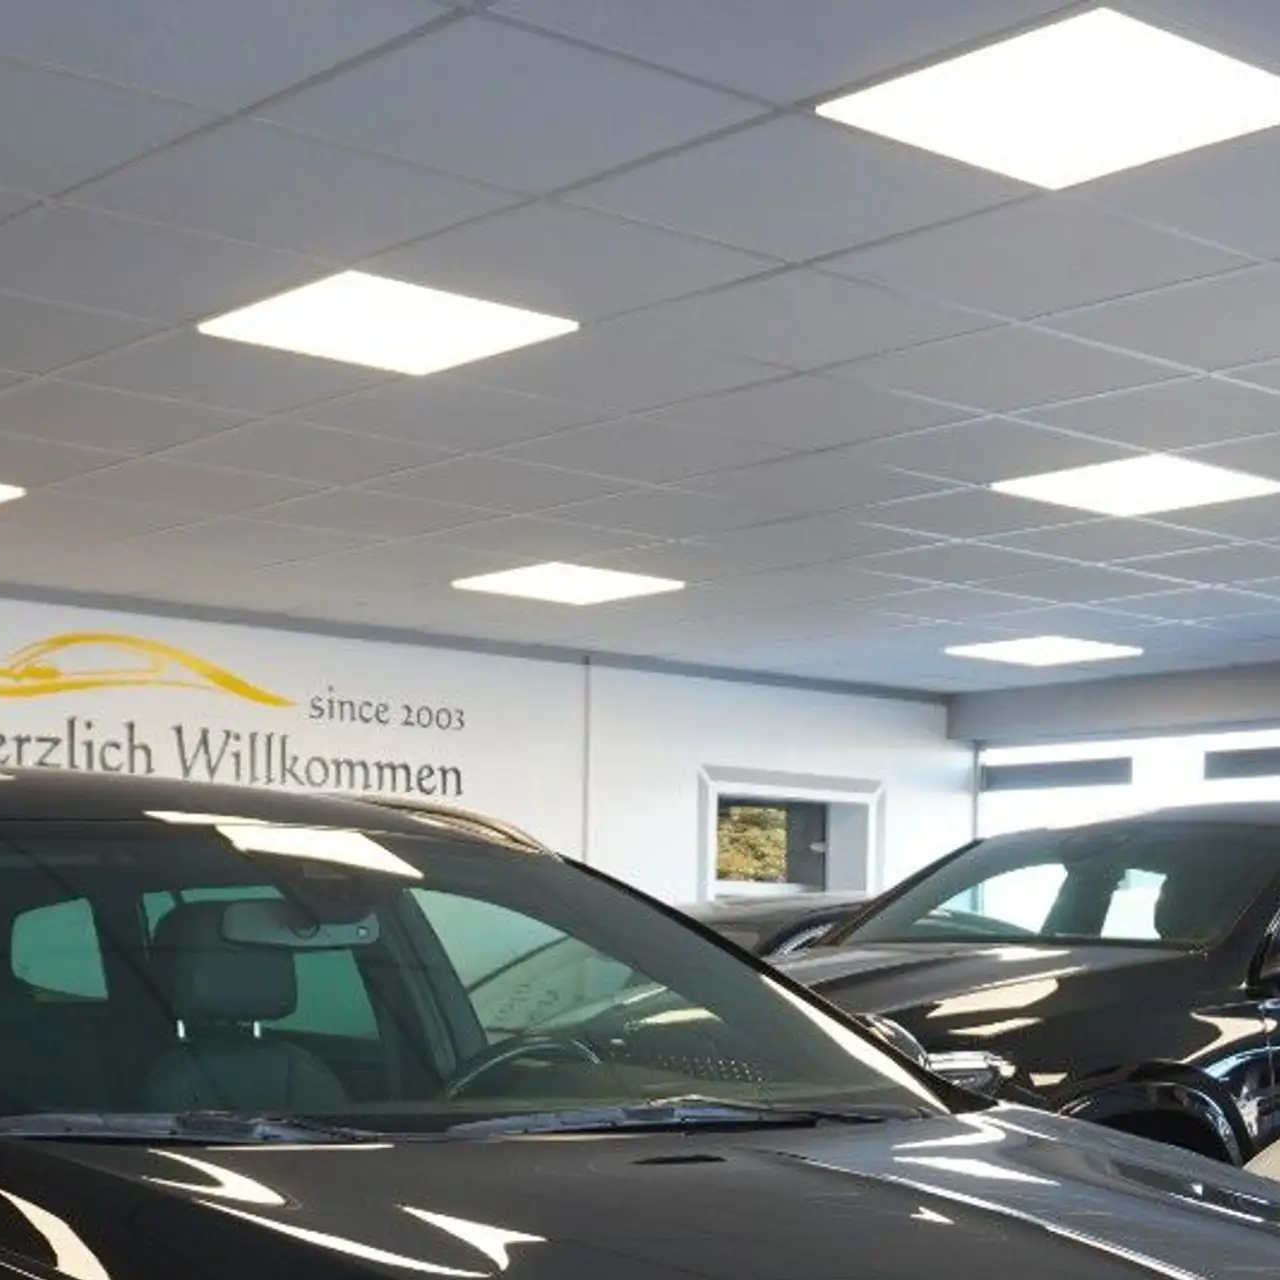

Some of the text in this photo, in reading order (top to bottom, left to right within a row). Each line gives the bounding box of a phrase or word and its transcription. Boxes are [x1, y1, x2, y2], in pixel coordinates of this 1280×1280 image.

[308, 684, 465, 731] since 2003
[170, 723, 464, 797] Willkommen
